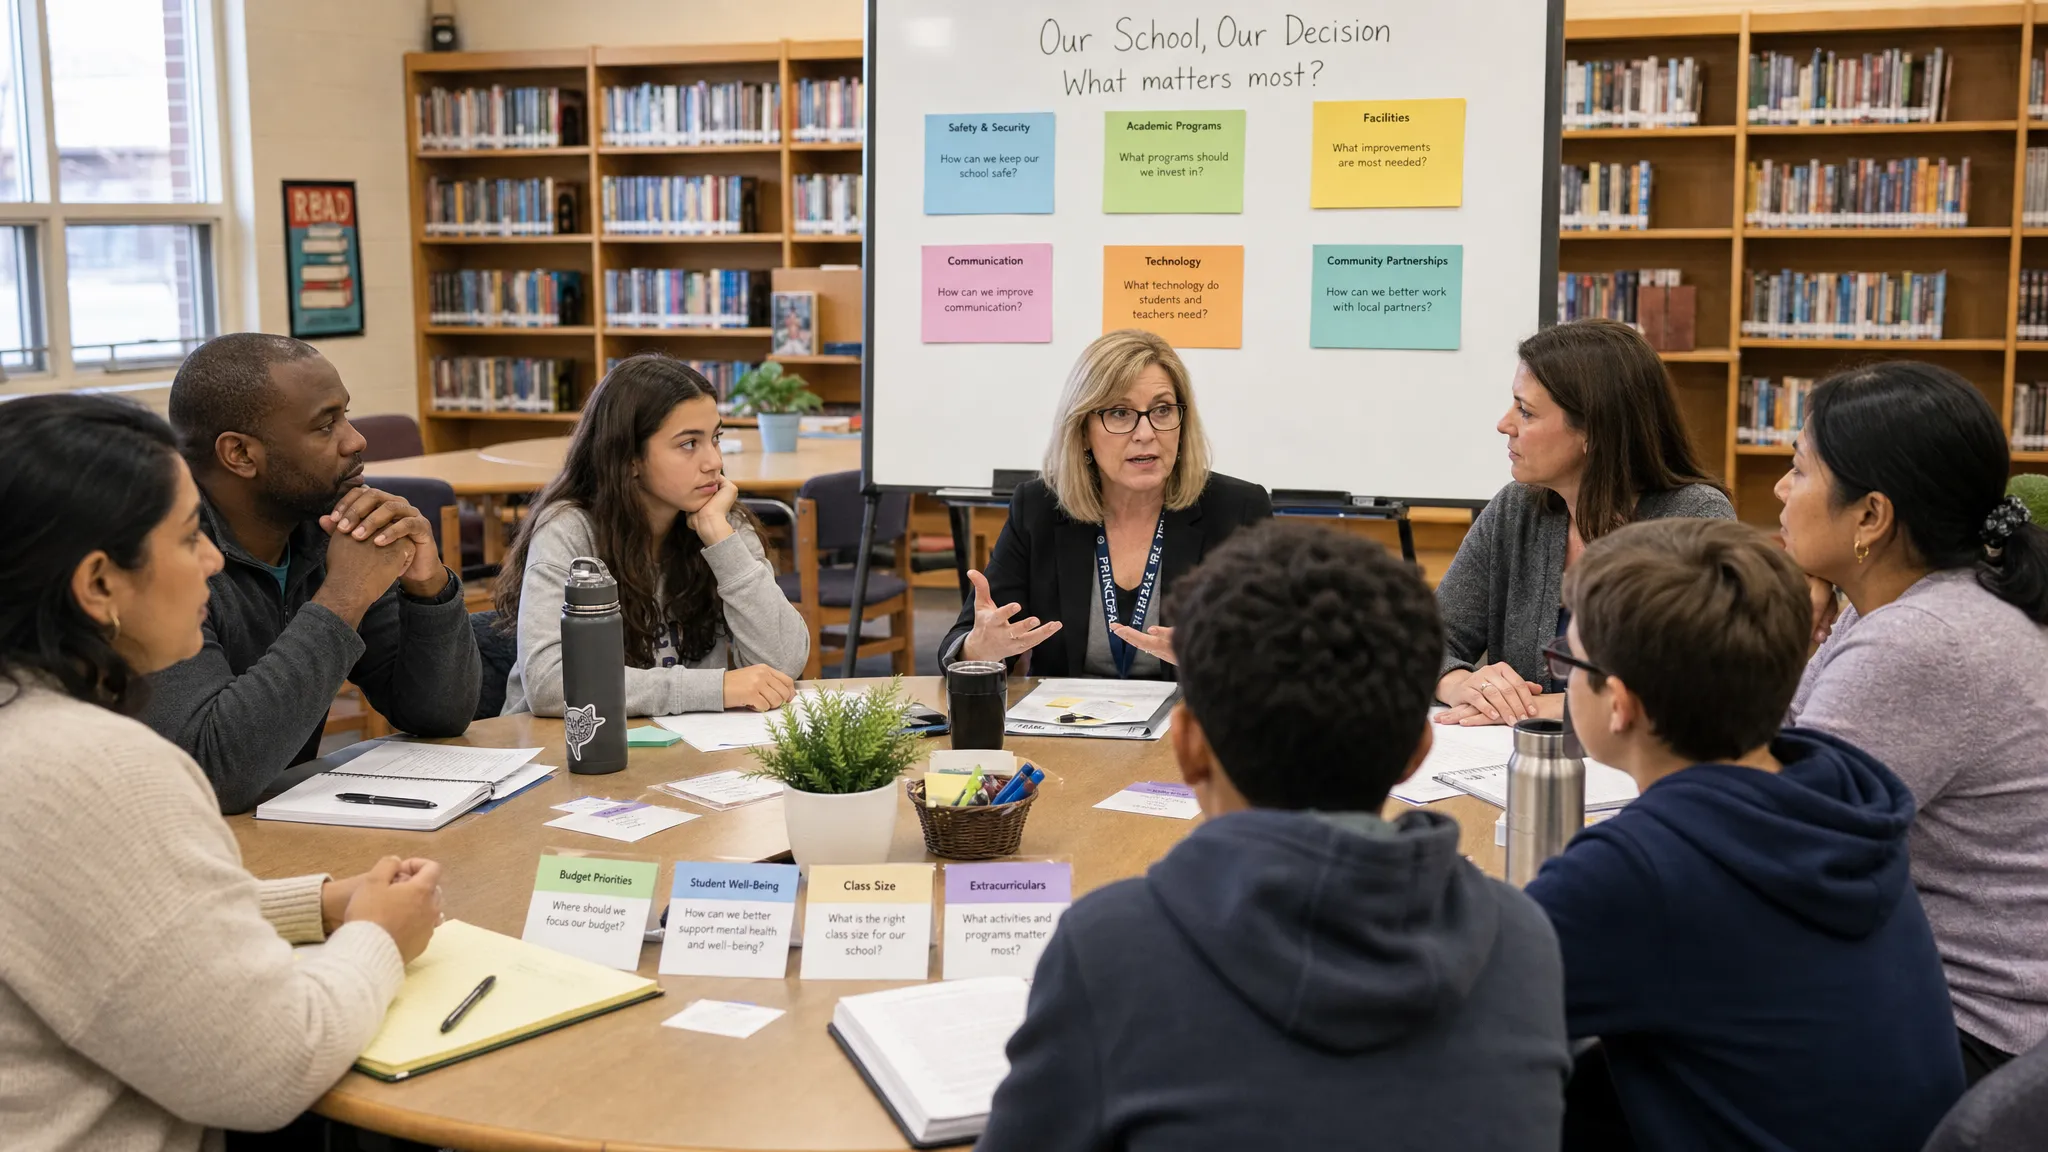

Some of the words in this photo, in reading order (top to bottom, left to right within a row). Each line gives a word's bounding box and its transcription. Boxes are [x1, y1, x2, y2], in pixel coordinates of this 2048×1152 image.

[1040, 18, 1092, 55] Our
[1114, 17, 1206, 54] School,
[1218, 15, 1267, 48] Our
[1286, 14, 1390, 45] Decision
[1064, 68, 1126, 96] What
[1143, 66, 1231, 91] matters
[1249, 60, 1323, 87] most?
[1364, 113, 1409, 122] Facilities
[949, 123, 977, 134] Safety
[981, 123, 988, 131] &
[992, 123, 1030, 134] Security
[1127, 121, 1172, 130] Academic
[1176, 121, 1221, 133] Programs
[1333, 143, 1358, 152] What
[1362, 143, 1430, 154] improvements
[941, 154, 961, 163] How
[1000, 154, 1021, 165] keep
[1119, 152, 1144, 161] What
[1148, 155, 1194, 165] programs
[1197, 152, 1228, 161] should
[1358, 159, 1381, 167] most
[1385, 157, 1427, 166] needed?
[960, 168, 988, 178] school
[992, 168, 1017, 177] safe?
[1157, 168, 1186, 176] invest
[1189, 167, 1203, 176] in?
[294, 191, 350, 221] READ
[948, 256, 1023, 265] Communication
[1145, 256, 1201, 268] Technology
[1327, 256, 1383, 268] Community
[1387, 256, 1448, 268] Partnerships
[1124, 280, 1149, 289] What
[1152, 280, 1204, 293] technology
[1207, 280, 1219, 289] do
[1327, 288, 1348, 296] How
[1389, 287, 1419, 296] better
[1422, 287, 1446, 296] work
[938, 288, 958, 296] How
[997, 288, 1033, 299] improve
[1140, 295, 1180, 304] students
[1184, 295, 1201, 304] and
[945, 302, 1022, 312] communication?
[1333, 302, 1354, 311] with
[1358, 302, 1380, 311] local
[1384, 302, 1432, 314] partners?
[1133, 309, 1174, 319] teachers
[1178, 309, 1208, 319] need?
[560, 870, 591, 883] Budget
[594, 873, 632, 885] Priorities
[690, 878, 726, 888] Student
[729, 880, 779, 893] Well-Being
[844, 880, 870, 890] Class
[875, 881, 896, 890] Size
[970, 880, 1046, 890] Extracurriculars
[553, 901, 580, 912] Where
[583, 903, 611, 914] should
[685, 908, 706, 917] How
[743, 910, 771, 920] better
[962, 914, 987, 923] What
[990, 914, 1031, 923] activities
[1034, 913, 1051, 923] and
[546, 915, 569, 926] focus
[588, 919, 625, 933] budget?
[828, 914, 852, 923] What
[856, 913, 863, 923] is
[866, 914, 880, 923] the
[883, 914, 905, 927] right
[679, 926, 714, 936] support
[716, 926, 747, 935] mental
[749, 925, 777, 936] health
[825, 929, 848, 939] class
[872, 929, 886, 939] for
[965, 932, 1011, 942] programs
[1014, 930, 1046, 939] matter
[688, 940, 705, 949] and
[708, 940, 764, 954] well-being?
[846, 945, 882, 955] school?
[991, 944, 1021, 955] most?
